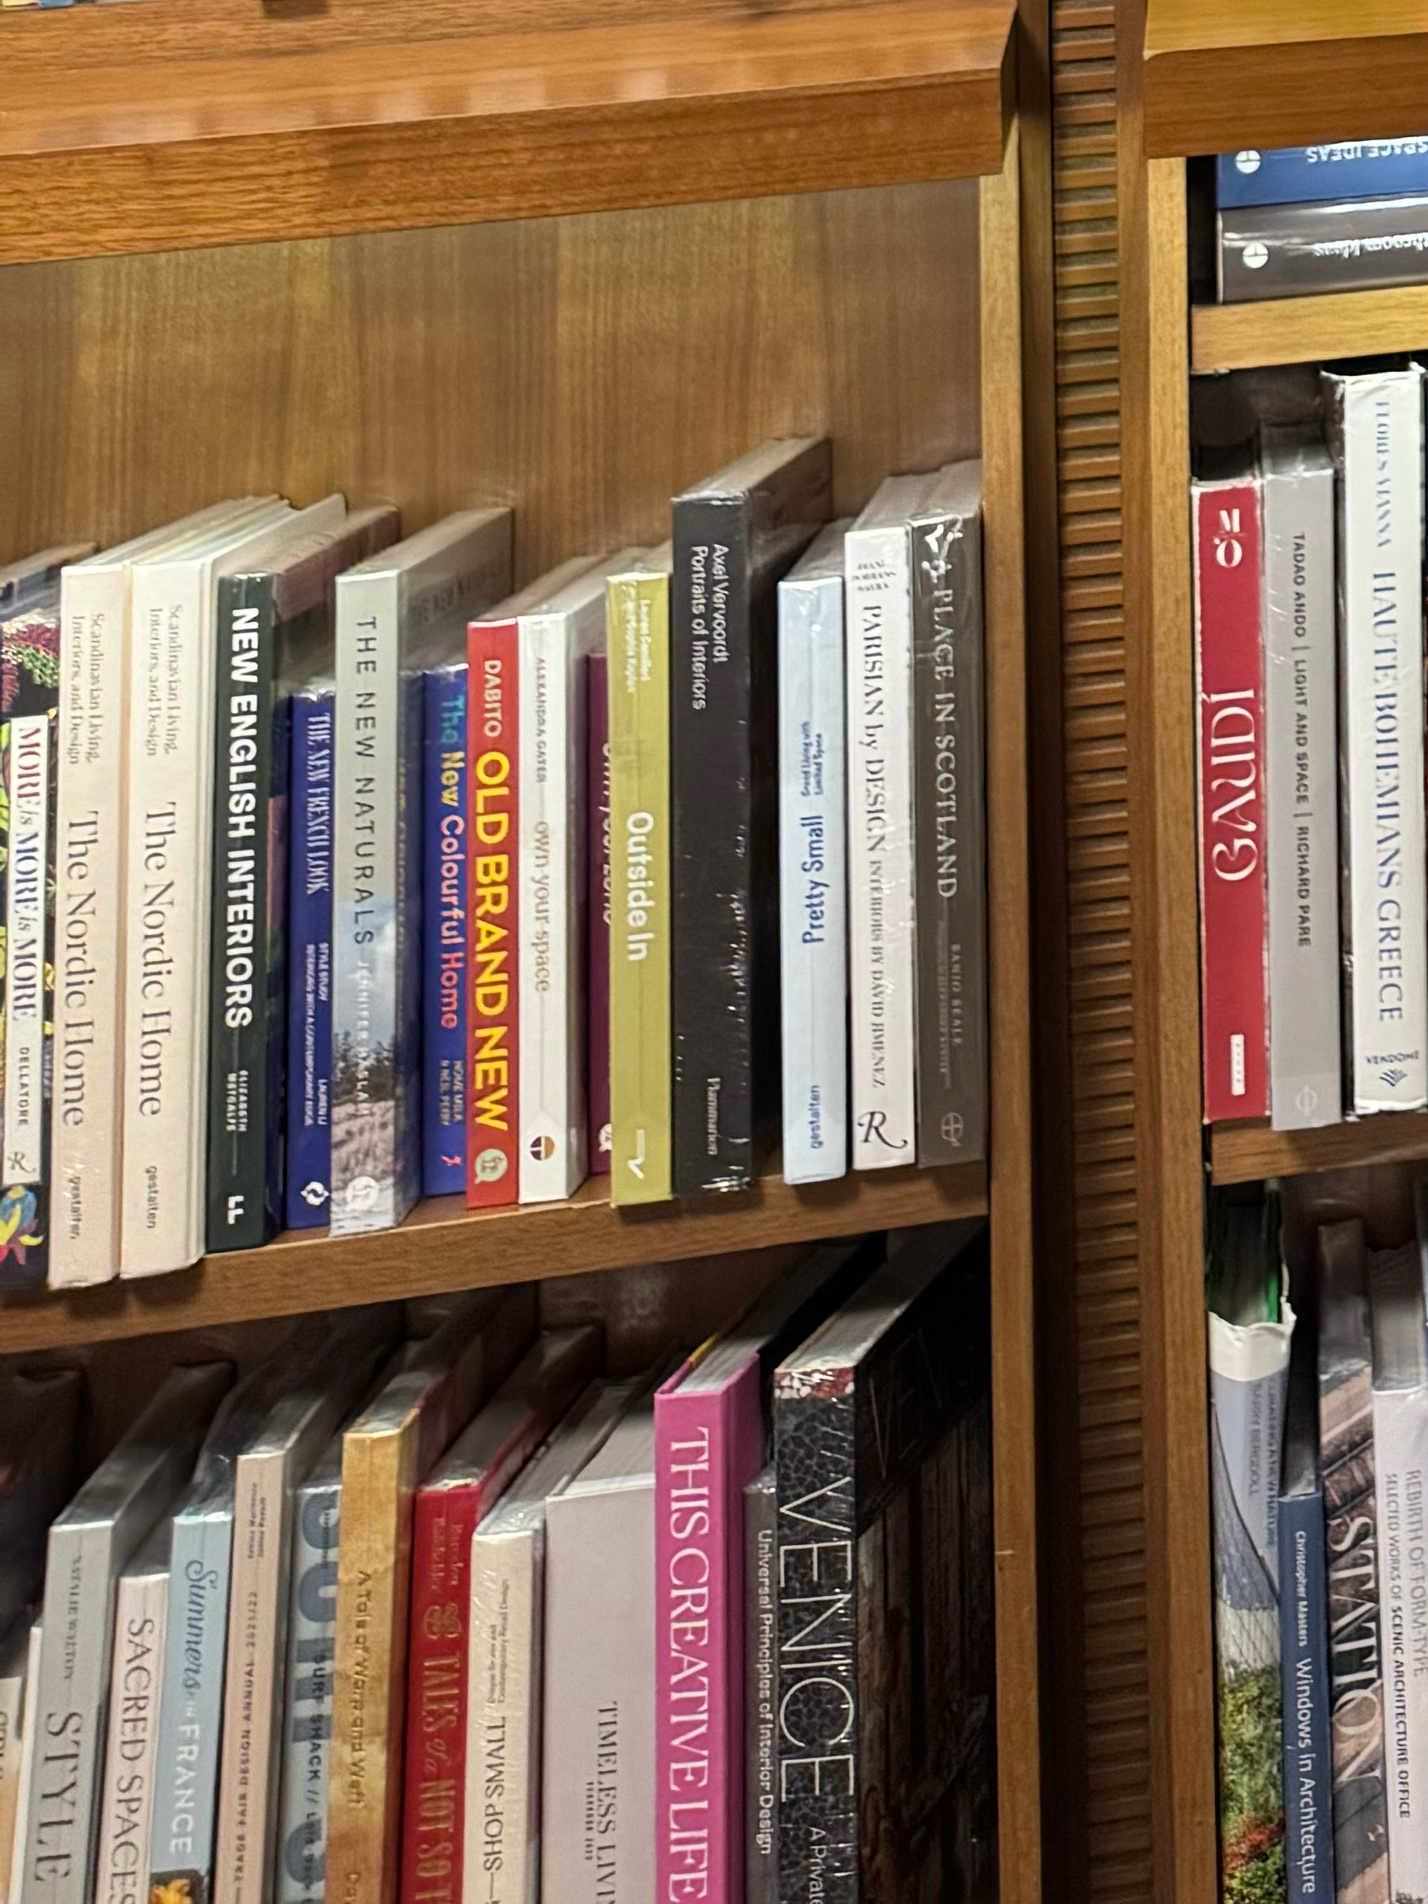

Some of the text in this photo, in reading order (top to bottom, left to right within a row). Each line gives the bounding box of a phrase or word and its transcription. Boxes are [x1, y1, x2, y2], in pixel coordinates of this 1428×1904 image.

[225, 607, 260, 1029] NEW ENGLISH INTERIORS
[354, 618, 378, 946] THE NEW NATURALS
[474, 659, 513, 1133] DABITO OLD BRAND NEW
[62, 809, 98, 1128] The Nordic Home
[33, 1710, 84, 1883] STYLE
[118, 1617, 157, 1760] SACRED
[169, 1723, 202, 1857] FRANCE
[481, 1715, 507, 1873] SHOP SMALL
[668, 1426, 710, 1902] THIS CREATIVE LIFE
[779, 1476, 855, 1803] VENICE
[1328, 1516, 1385, 1785] STATION
